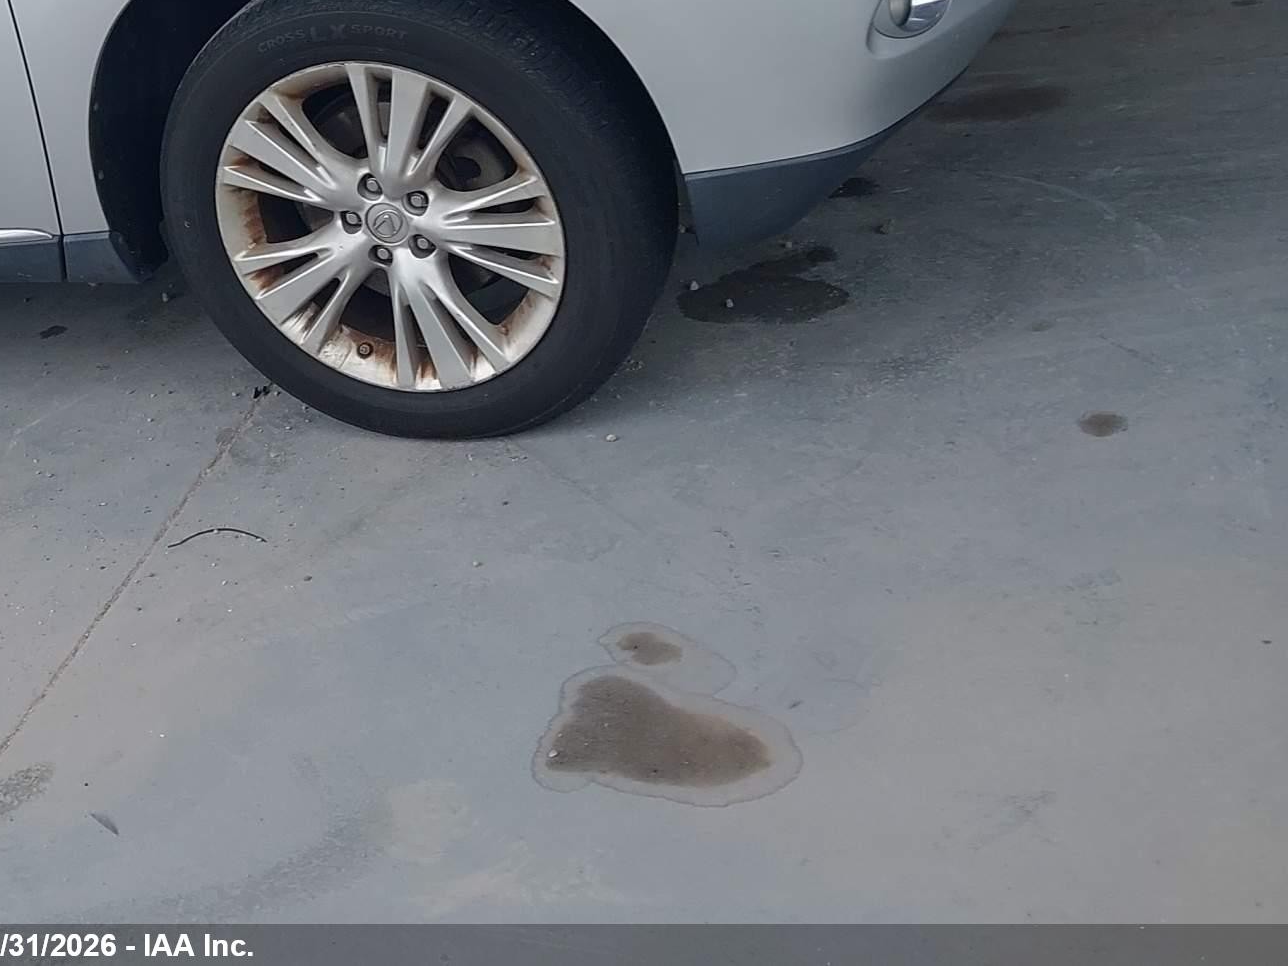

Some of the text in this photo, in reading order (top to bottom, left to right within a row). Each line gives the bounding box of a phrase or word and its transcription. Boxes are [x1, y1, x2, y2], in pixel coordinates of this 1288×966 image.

[257, 24, 408, 52] CROSS LX SPORT
